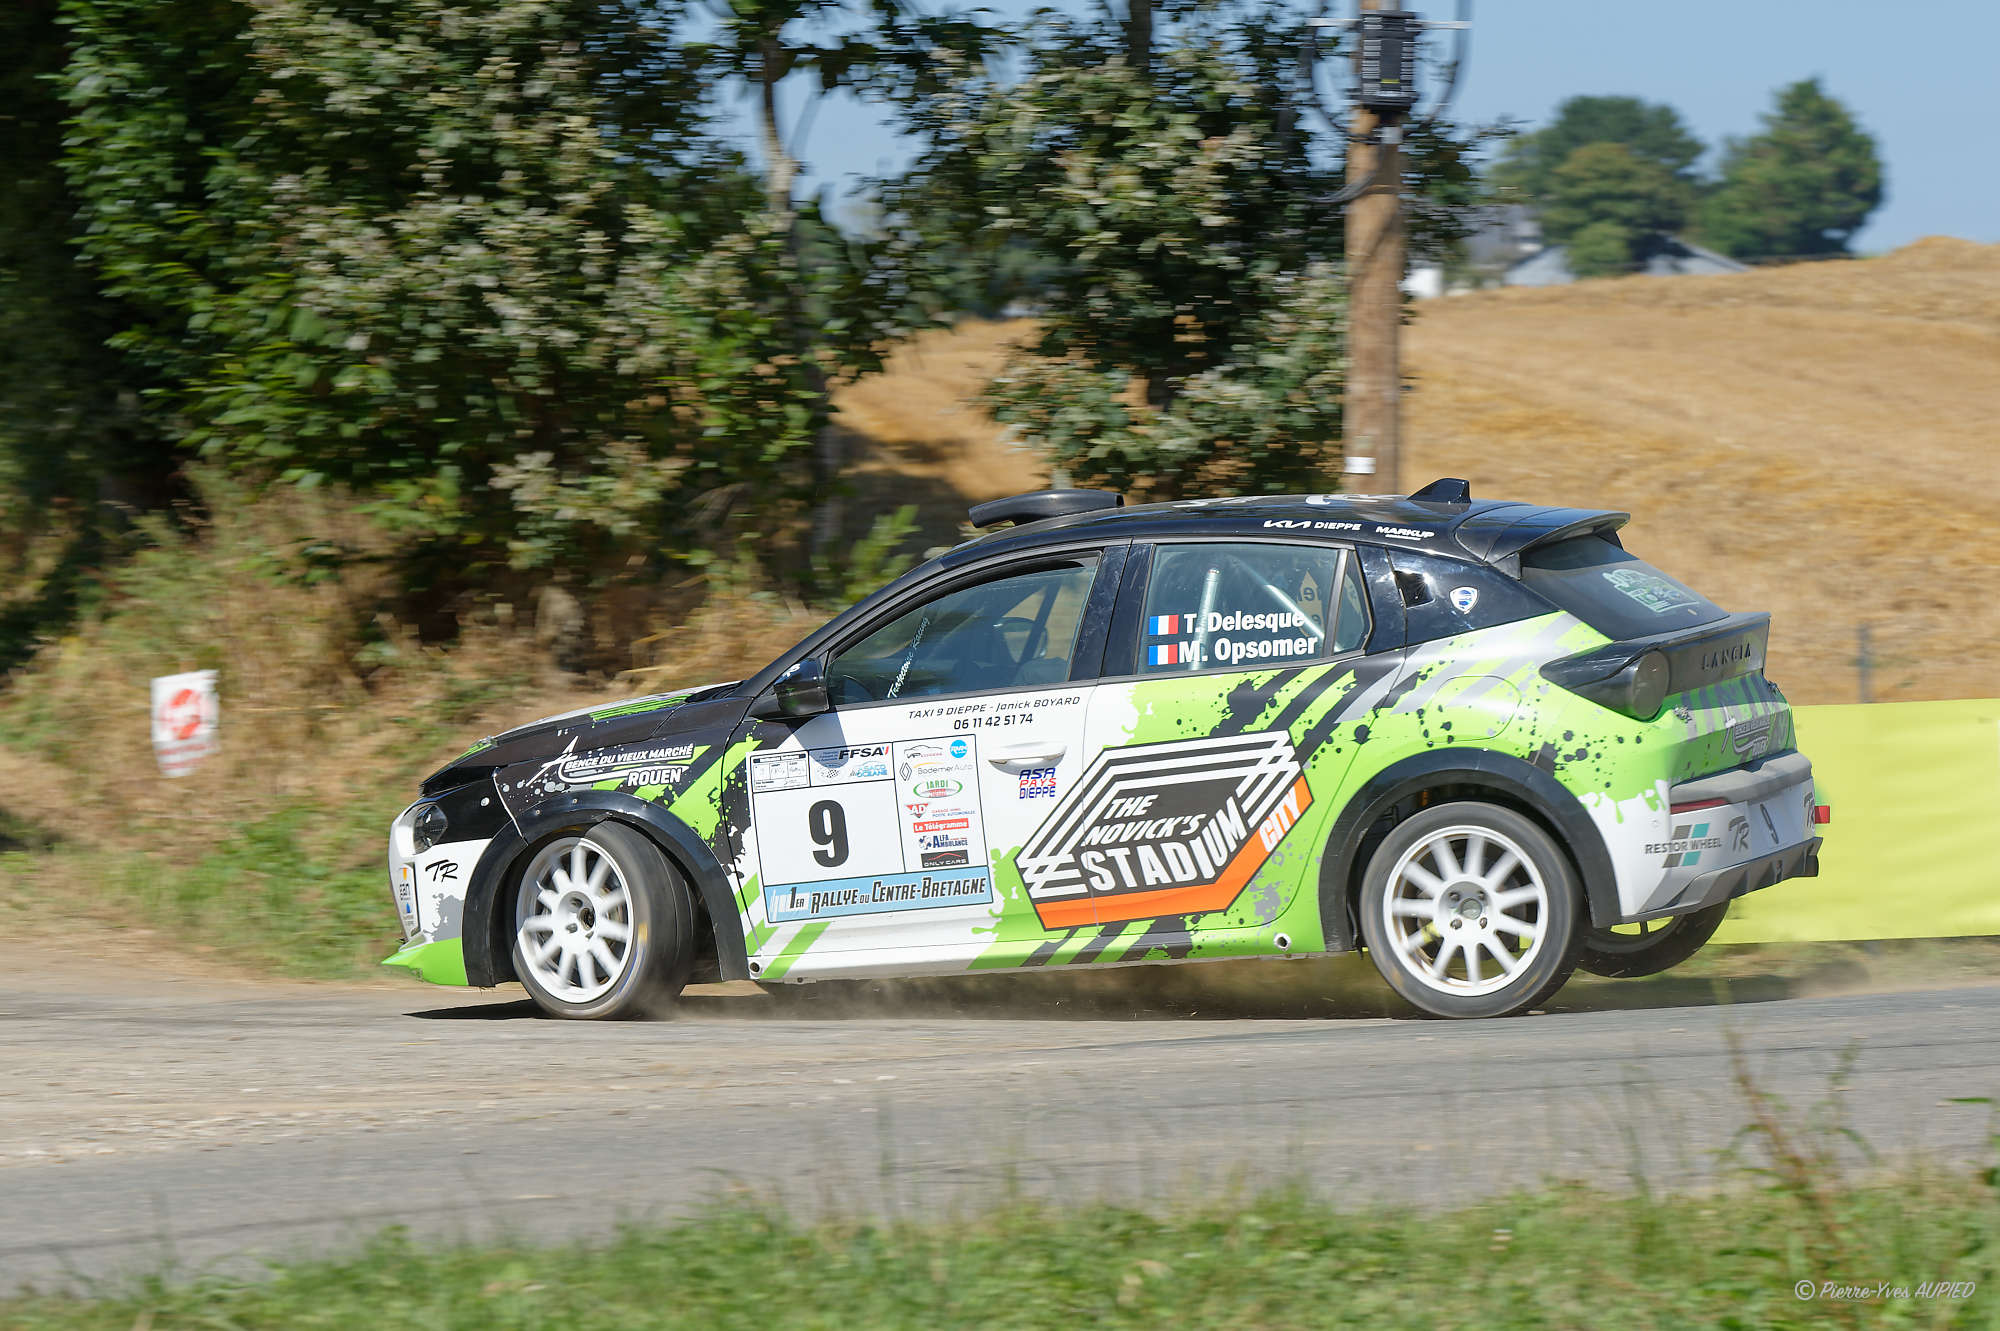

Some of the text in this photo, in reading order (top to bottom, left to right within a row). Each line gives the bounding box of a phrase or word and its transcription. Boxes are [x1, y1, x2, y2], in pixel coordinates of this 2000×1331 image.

[1263, 520, 1362, 531] KIA DIEPPE
[1375, 525, 1435, 538] MARKUP
[1183, 610, 1306, 634] T. Delesque
[1179, 637, 1318, 664] M. Opsomer
[1701, 643, 1751, 670] LANCIA
[908, 709, 934, 719] TAXI
[937, 708, 943, 716] 9
[945, 704, 987, 716] DIEPPE
[995, 702, 1030, 712] Janick
[1033, 696, 1081, 708] BOYARD
[953, 713, 1033, 730] 06 11 42 51 74
[599, 755, 616, 765] DU
[617, 751, 648, 763] VIEUX
[649, 743, 694, 759] MARCHÉ
[838, 746, 884, 760] FFSA
[628, 768, 682, 786] ROUEN
[1019, 767, 1056, 780] ASA
[1019, 778, 1057, 788] PAYS
[1019, 786, 1056, 799] DIEPPE
[911, 804, 927, 814] AD
[1103, 794, 1159, 820] THE
[924, 821, 968, 831] Télégramme
[1259, 784, 1302, 853] CITY
[808, 799, 850, 868] 9
[1081, 814, 1207, 847] NOVICK'S
[1728, 815, 1750, 851] TR
[1080, 796, 1248, 891] STADIUM
[1645, 837, 1722, 854] RESTOR WHEEL
[425, 859, 459, 883] TR
[811, 889, 859, 914] RALLYE
[859, 894, 870, 904] DU
[871, 877, 986, 903] CENTRE-BRETAGNE
